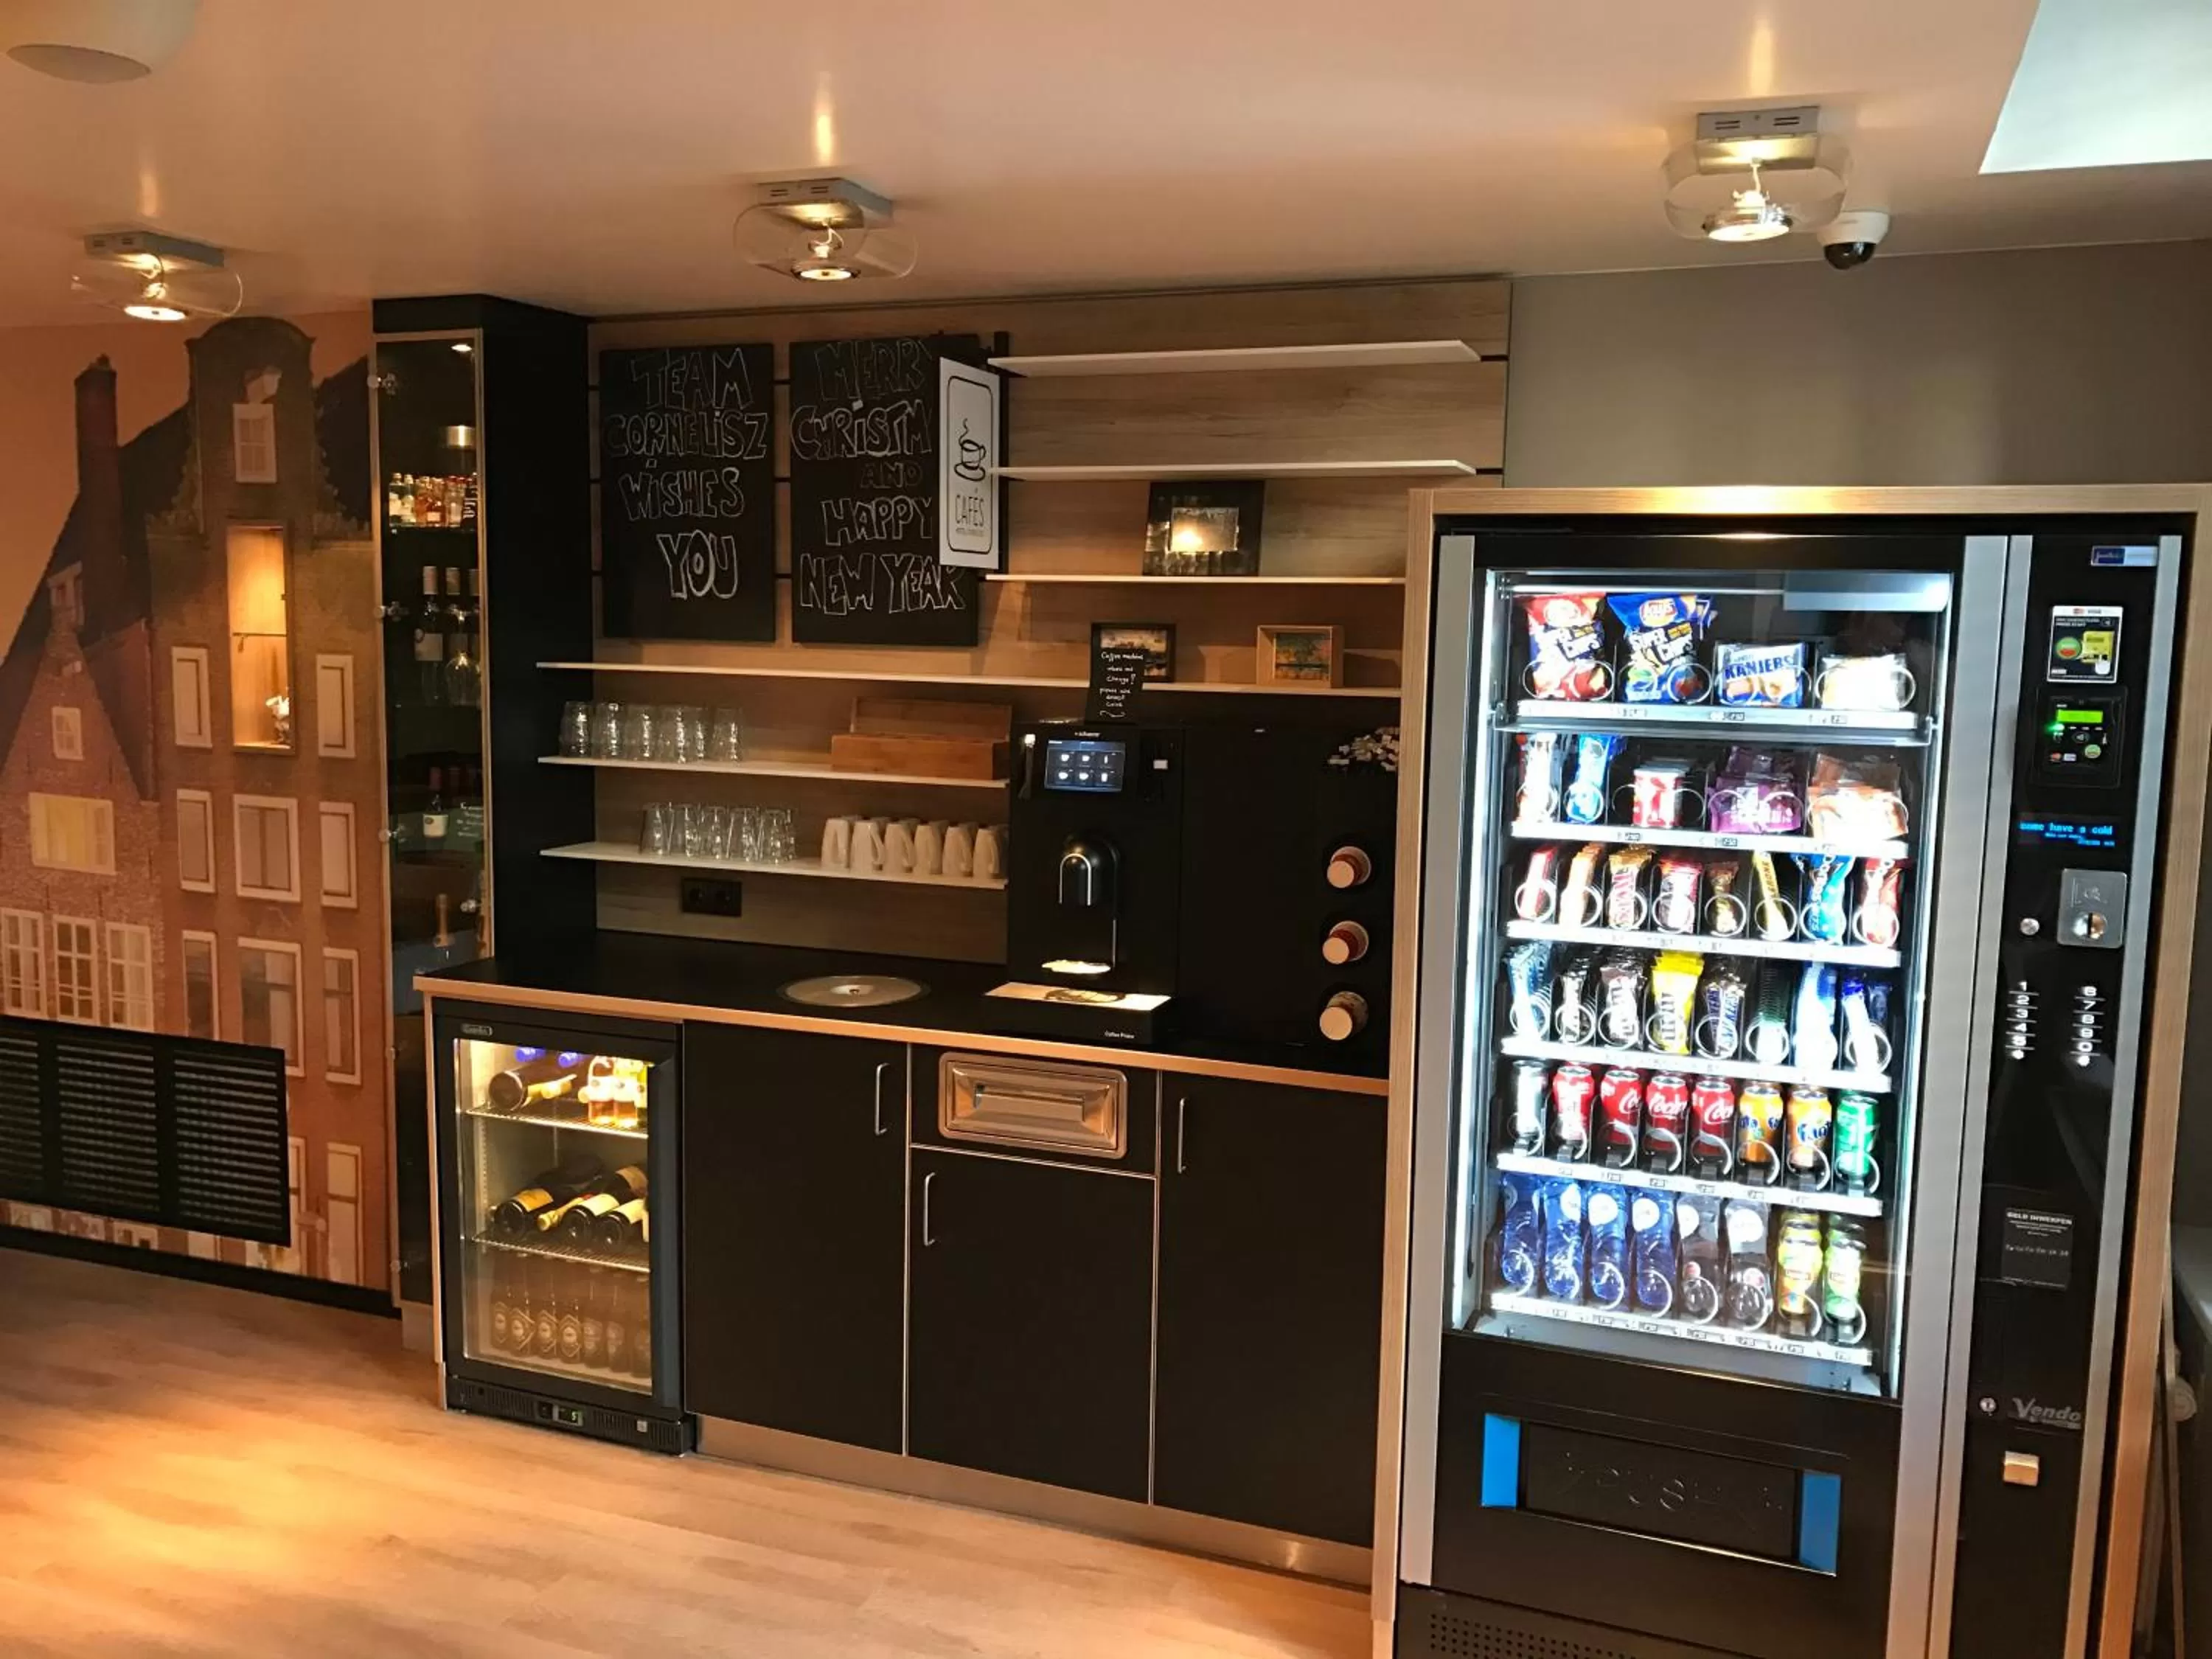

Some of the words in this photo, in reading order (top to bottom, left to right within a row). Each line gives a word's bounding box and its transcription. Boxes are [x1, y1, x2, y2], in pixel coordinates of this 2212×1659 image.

[631, 347, 753, 412] TEAM
[790, 399, 932, 461] CHRISTM
[860, 460, 923, 491] AND
[821, 495, 931, 546] HAPPY
[656, 529, 738, 600] YOU
[800, 552, 876, 616] NEW
[2016, 1008, 2028, 1018] 3
[2017, 995, 2030, 1005] 2
[2083, 1001, 2096, 1010] 7
[2014, 1023, 2027, 1032] 4
[2079, 1042, 2093, 1052] 0
[2012, 1397, 2082, 1422] Vendo
